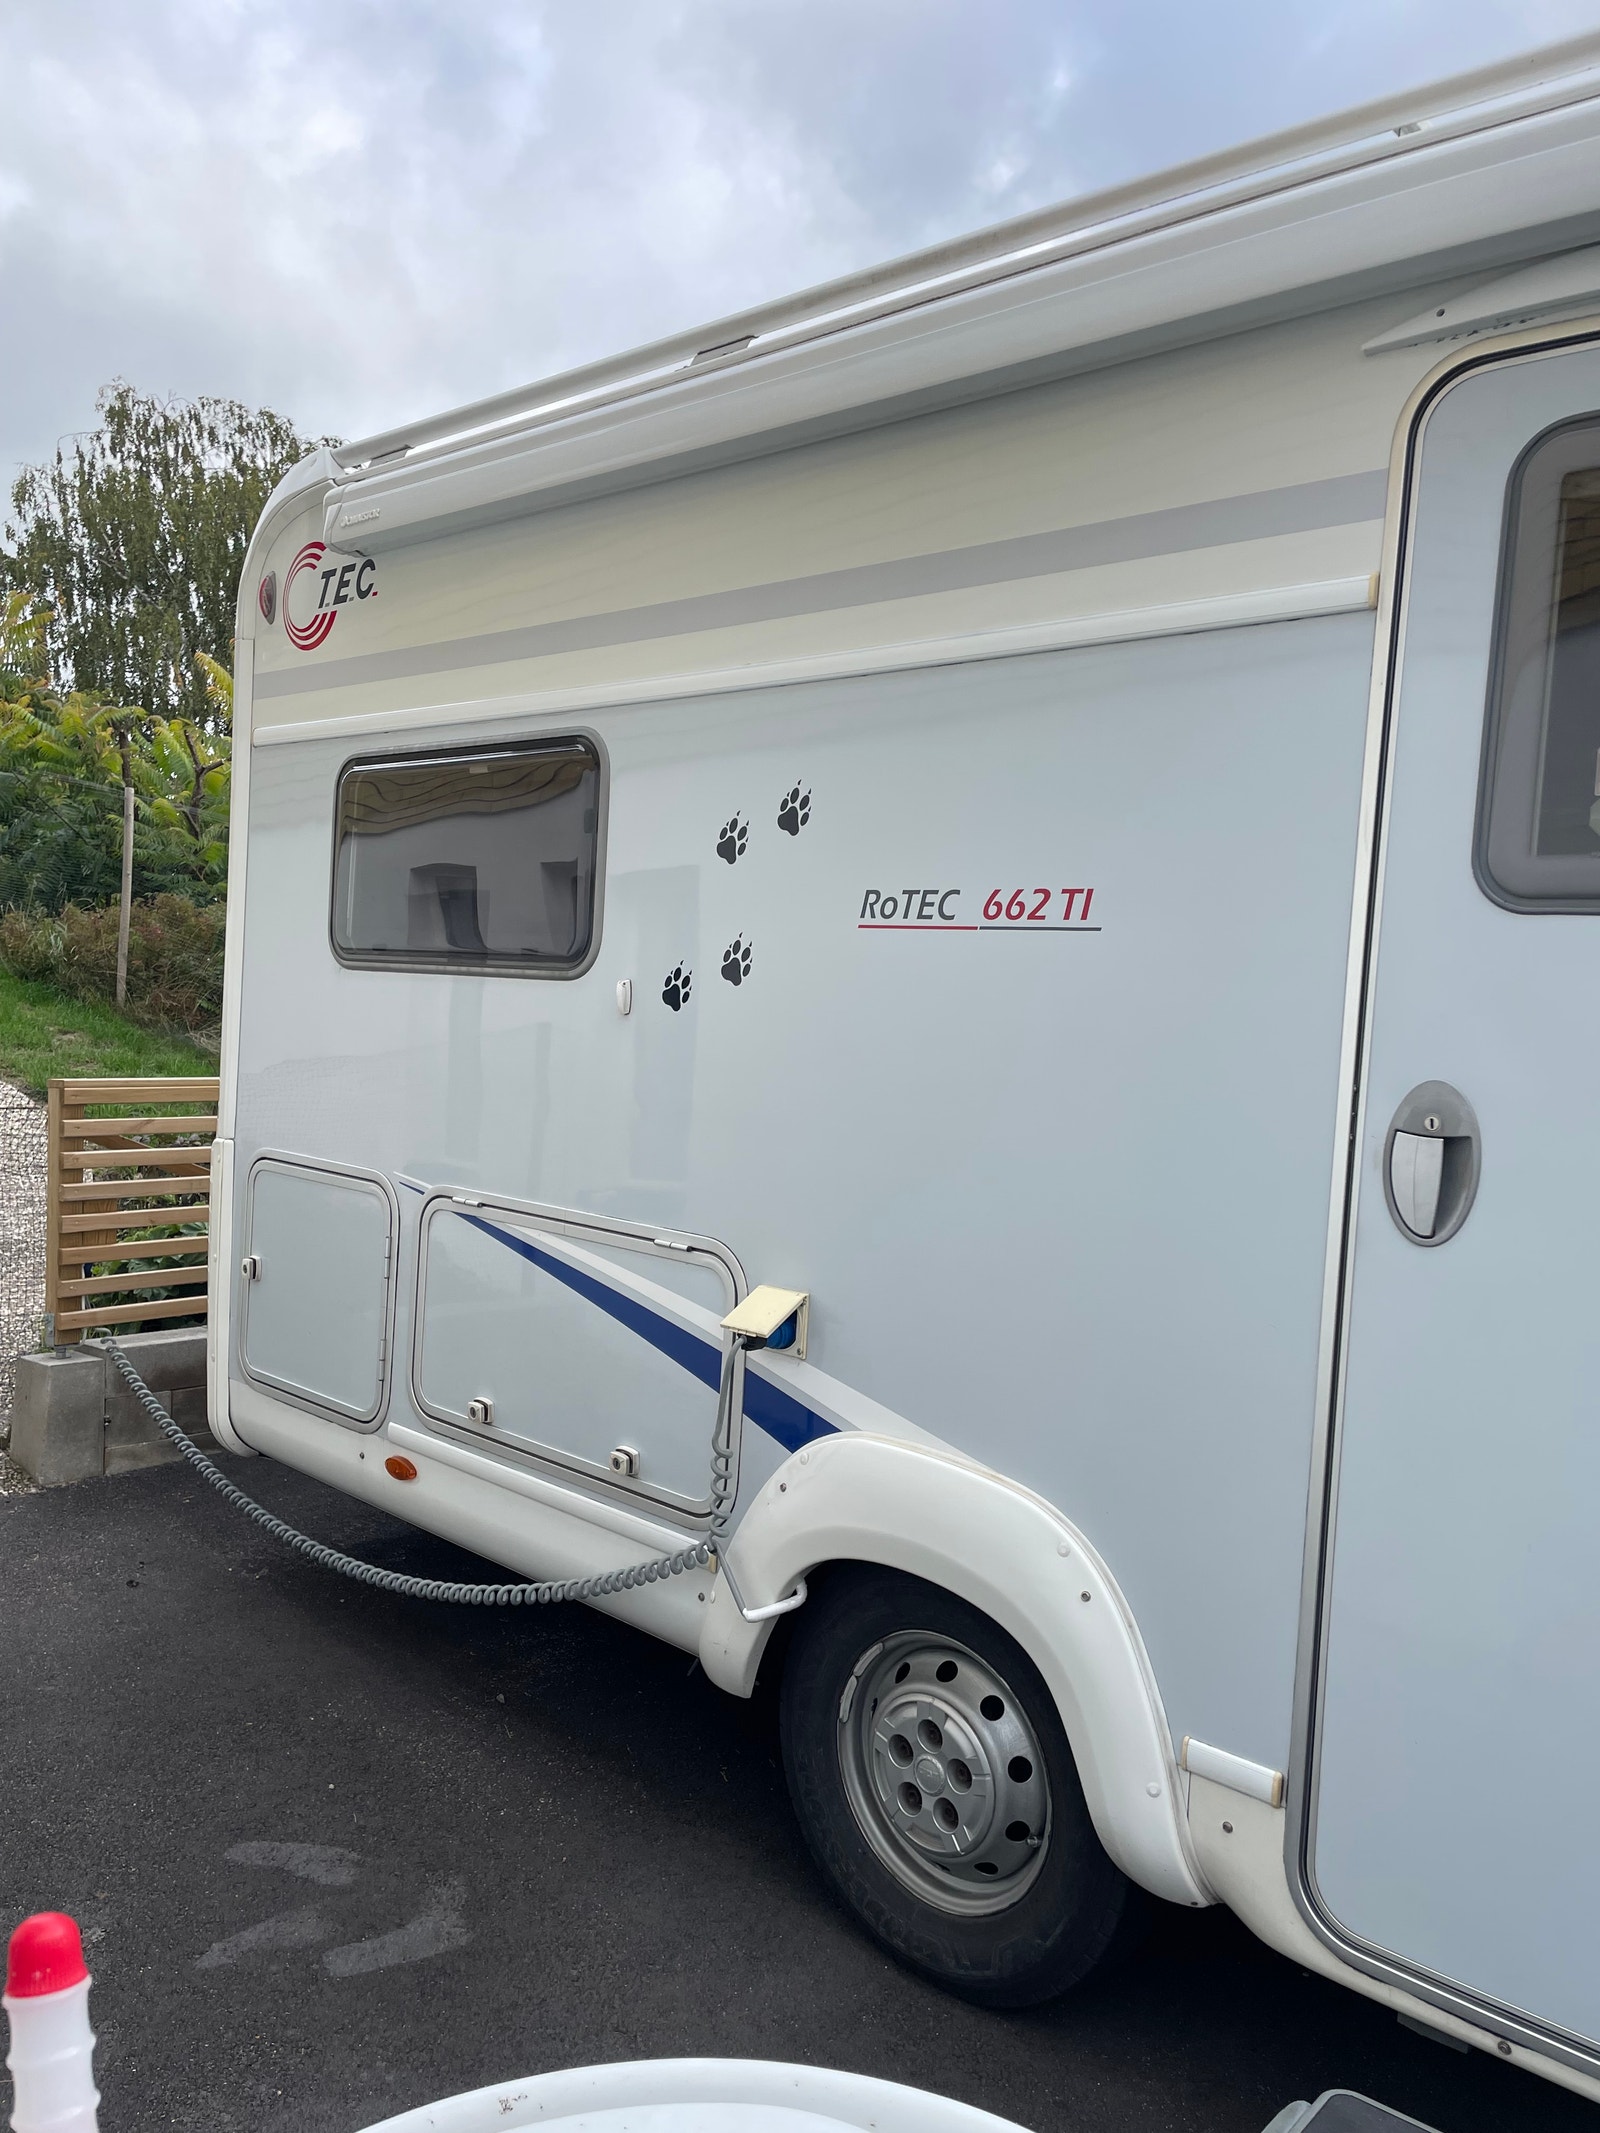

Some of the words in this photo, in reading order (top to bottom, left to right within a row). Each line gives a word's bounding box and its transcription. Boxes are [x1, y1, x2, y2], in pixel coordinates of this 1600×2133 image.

[860, 889, 961, 921] RoTEC
[982, 888, 1052, 921] 662
[1060, 888, 1095, 921] TI
